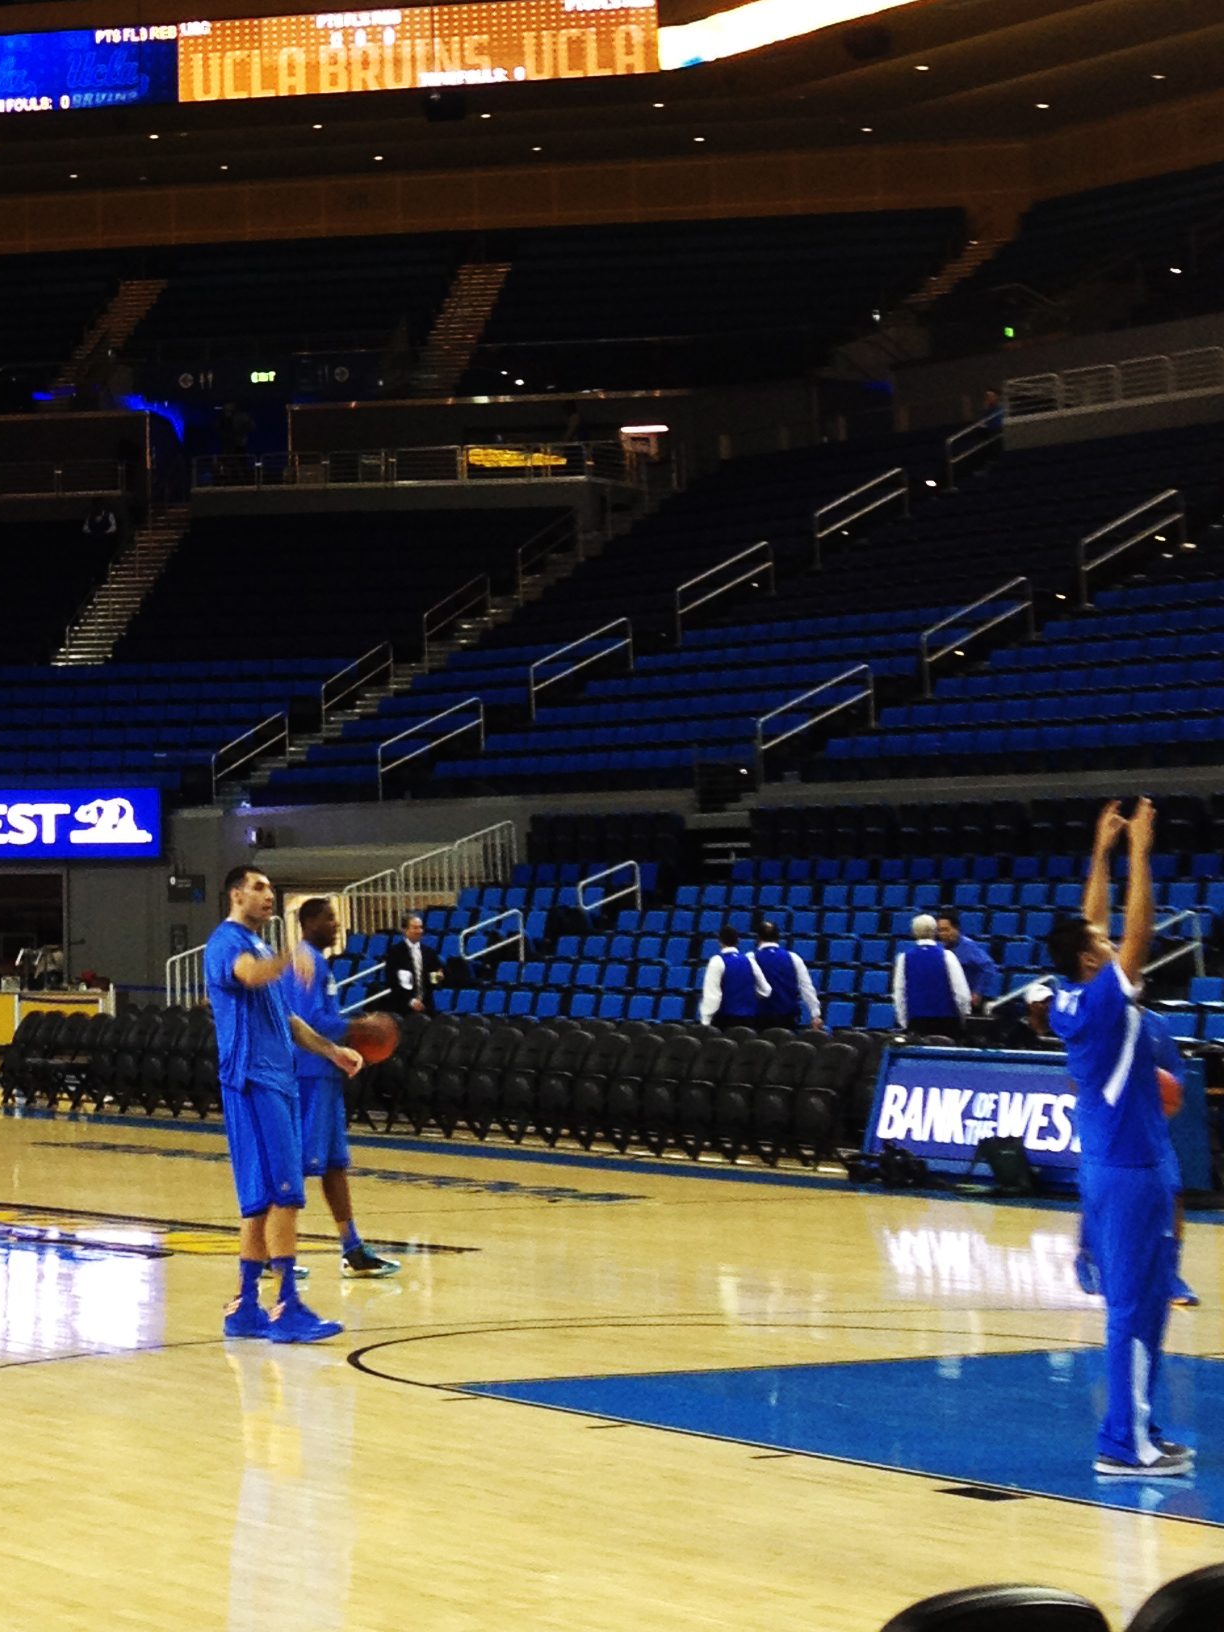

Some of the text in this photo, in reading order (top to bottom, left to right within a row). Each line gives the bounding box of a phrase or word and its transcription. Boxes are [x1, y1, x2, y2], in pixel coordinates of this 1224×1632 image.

[191, 24, 647, 100] UCLA BRUINS UCLA
[877, 1084, 1081, 1153] BANK OF THE WES
